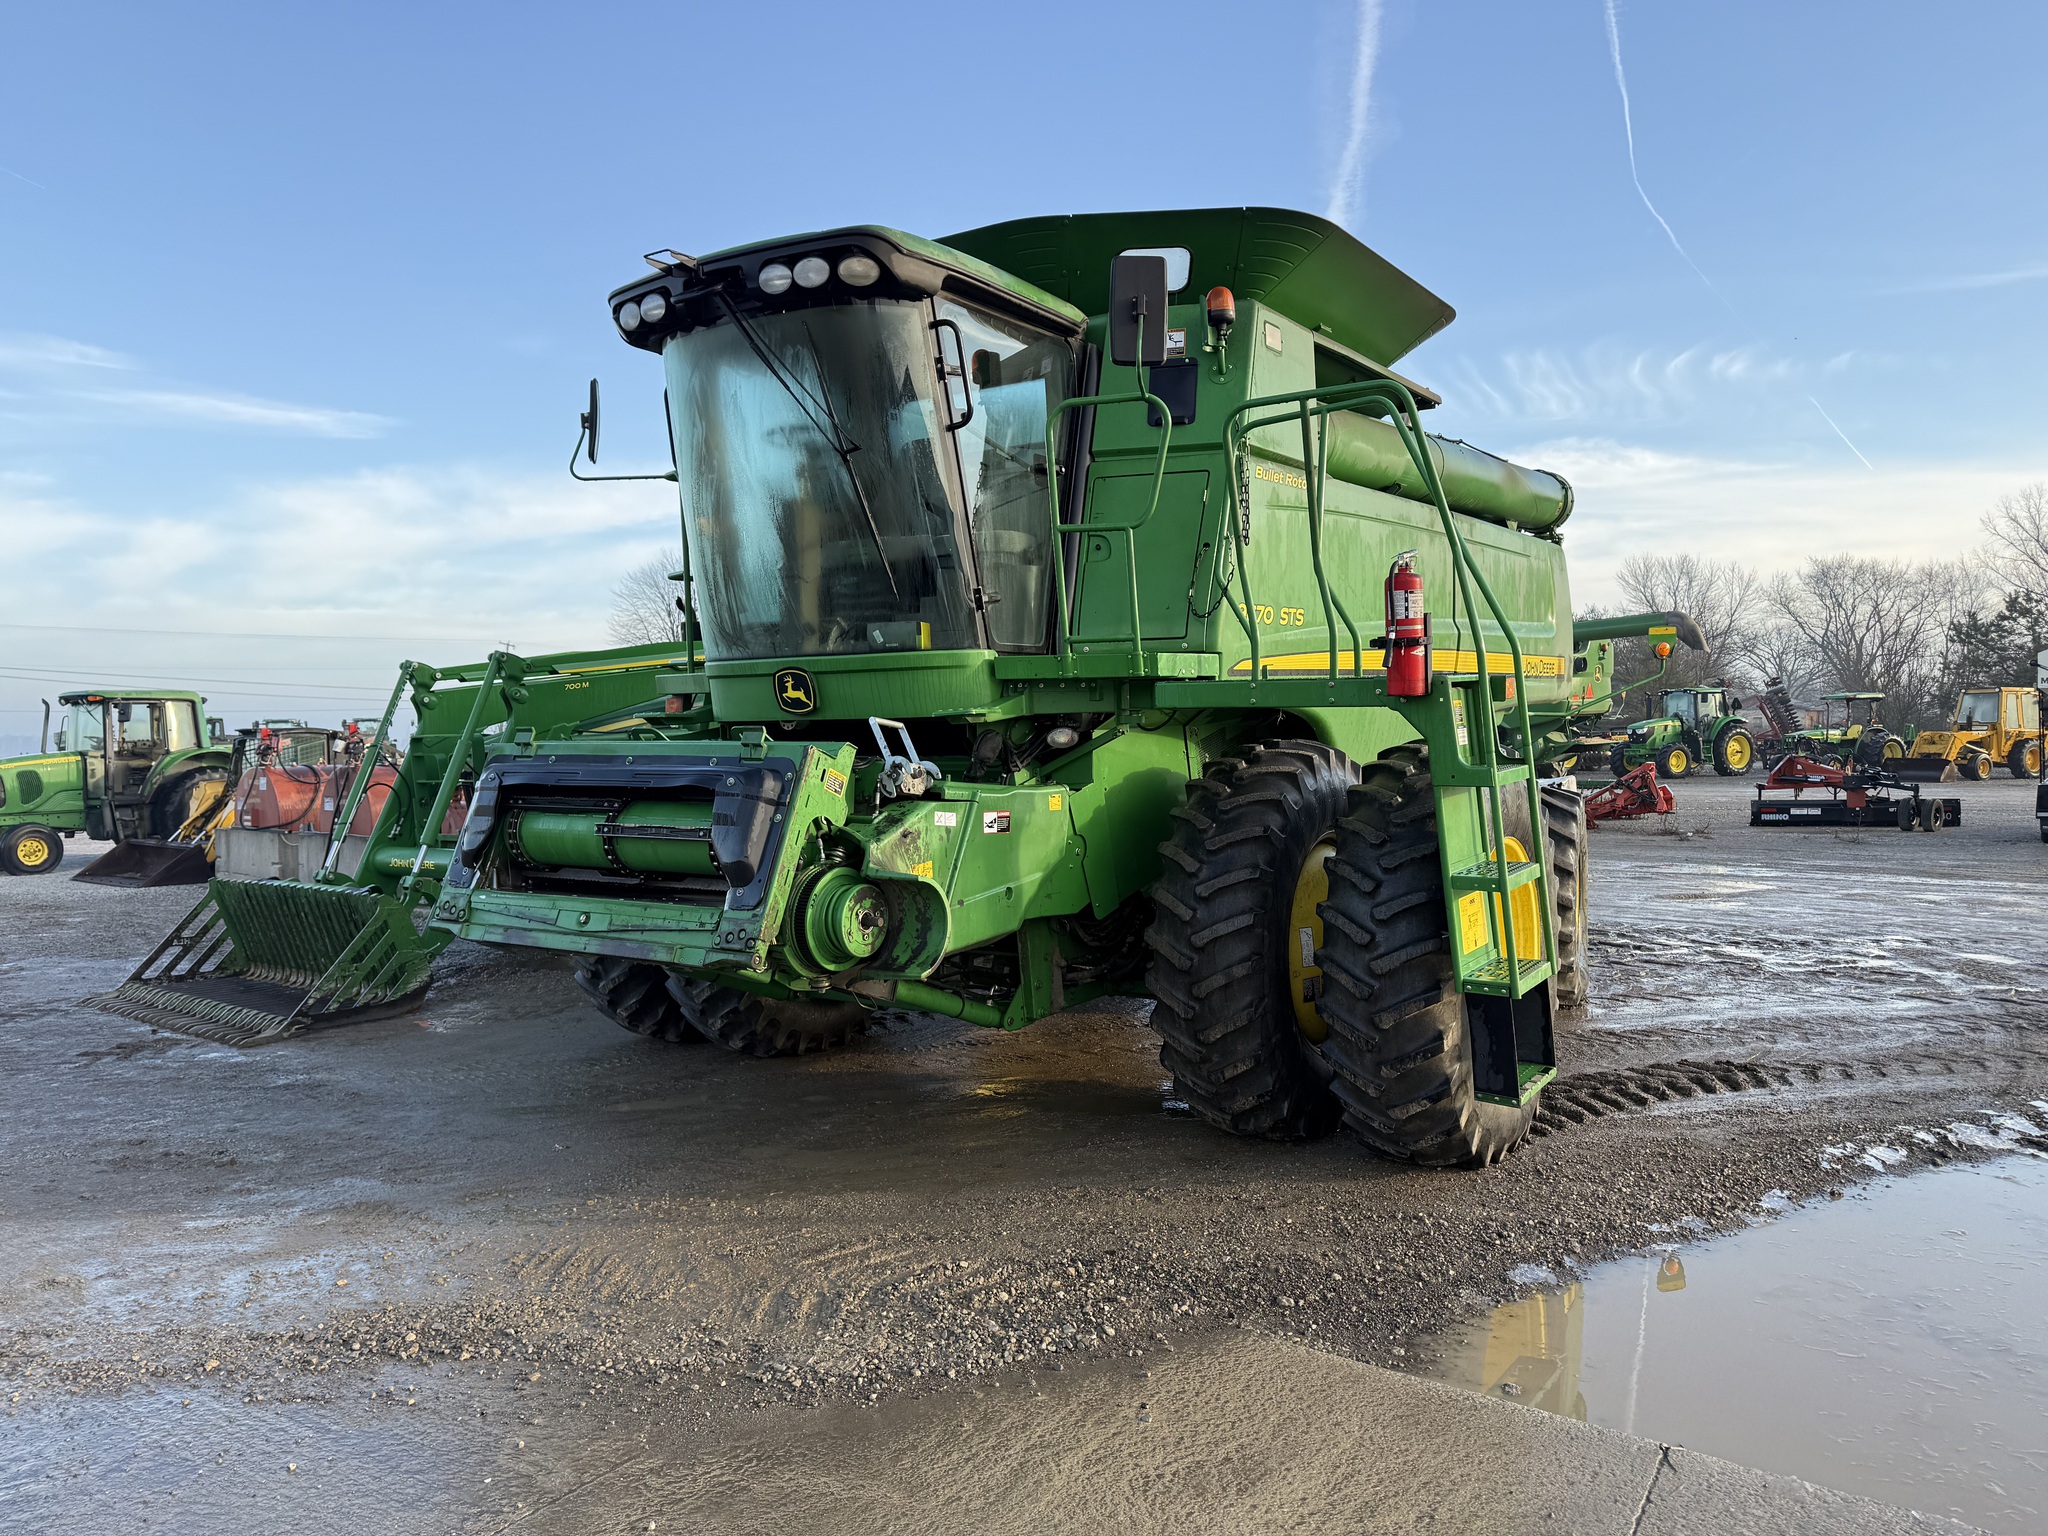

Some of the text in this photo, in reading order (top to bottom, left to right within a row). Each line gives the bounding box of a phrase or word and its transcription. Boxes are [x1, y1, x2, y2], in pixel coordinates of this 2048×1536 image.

[1255, 465, 1307, 490] Bullet Roto
[1237, 603, 1305, 626] 970 STS
[1523, 658, 1556, 675] JOHN DEERE
[564, 681, 590, 691] 700 M
[1761, 813, 1790, 821] RHINO
[389, 857, 409, 868] JOHN
